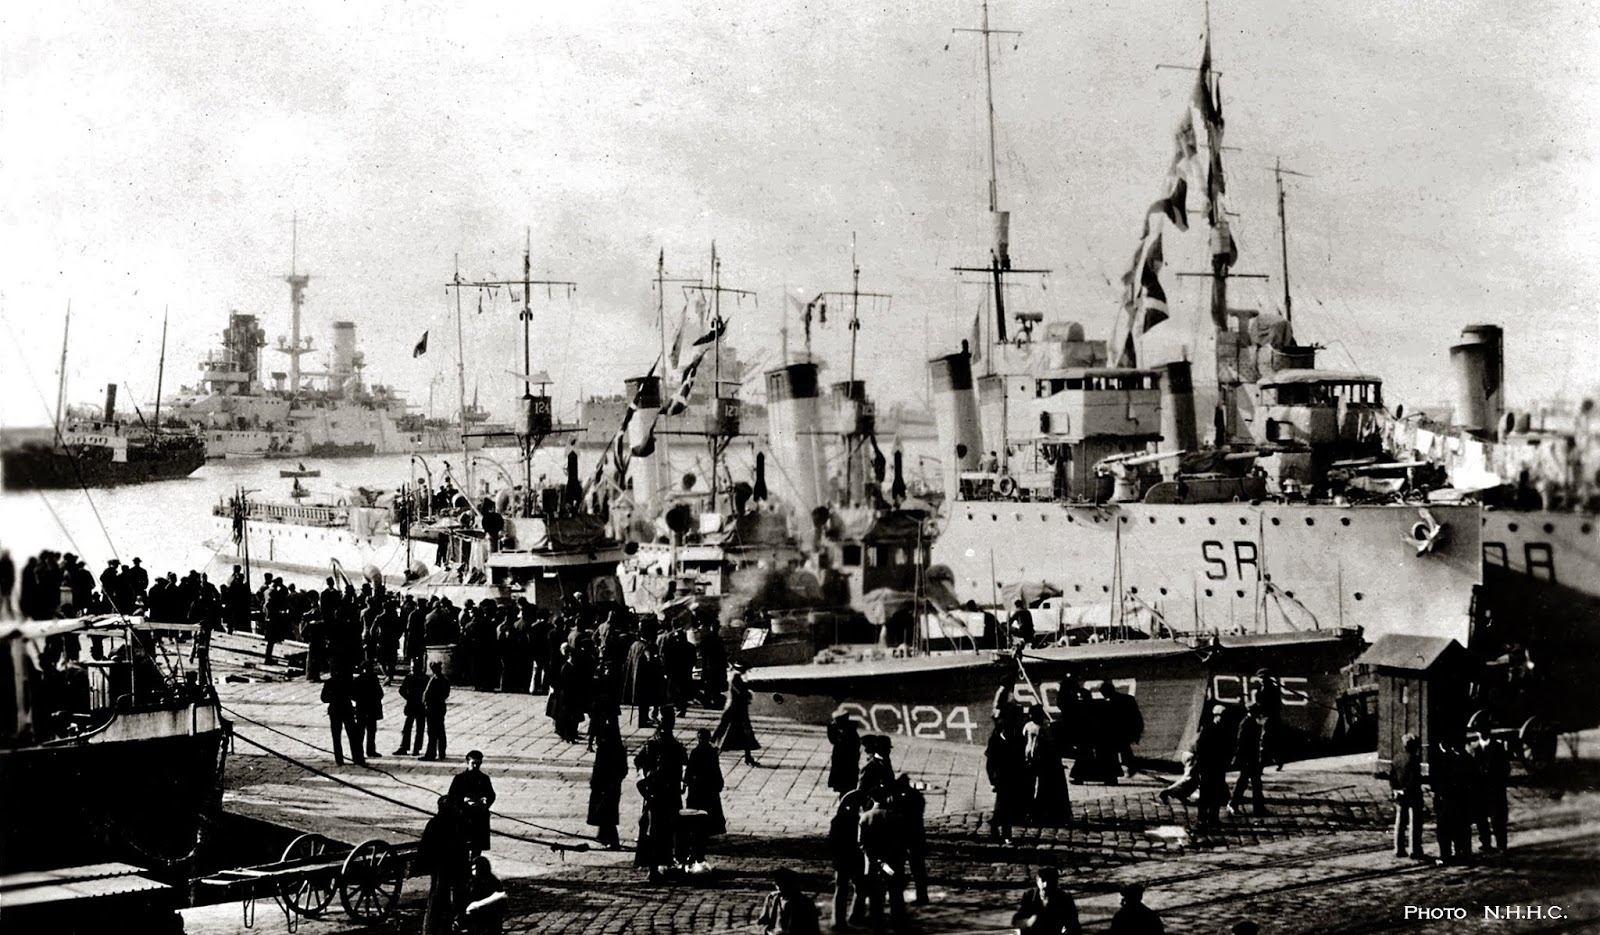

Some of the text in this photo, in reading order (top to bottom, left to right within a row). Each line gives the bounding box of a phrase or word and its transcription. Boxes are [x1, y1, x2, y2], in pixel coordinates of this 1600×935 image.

[535, 401, 550, 414] 124
[1202, 541, 1262, 581] SR
[836, 702, 978, 741] SC124
